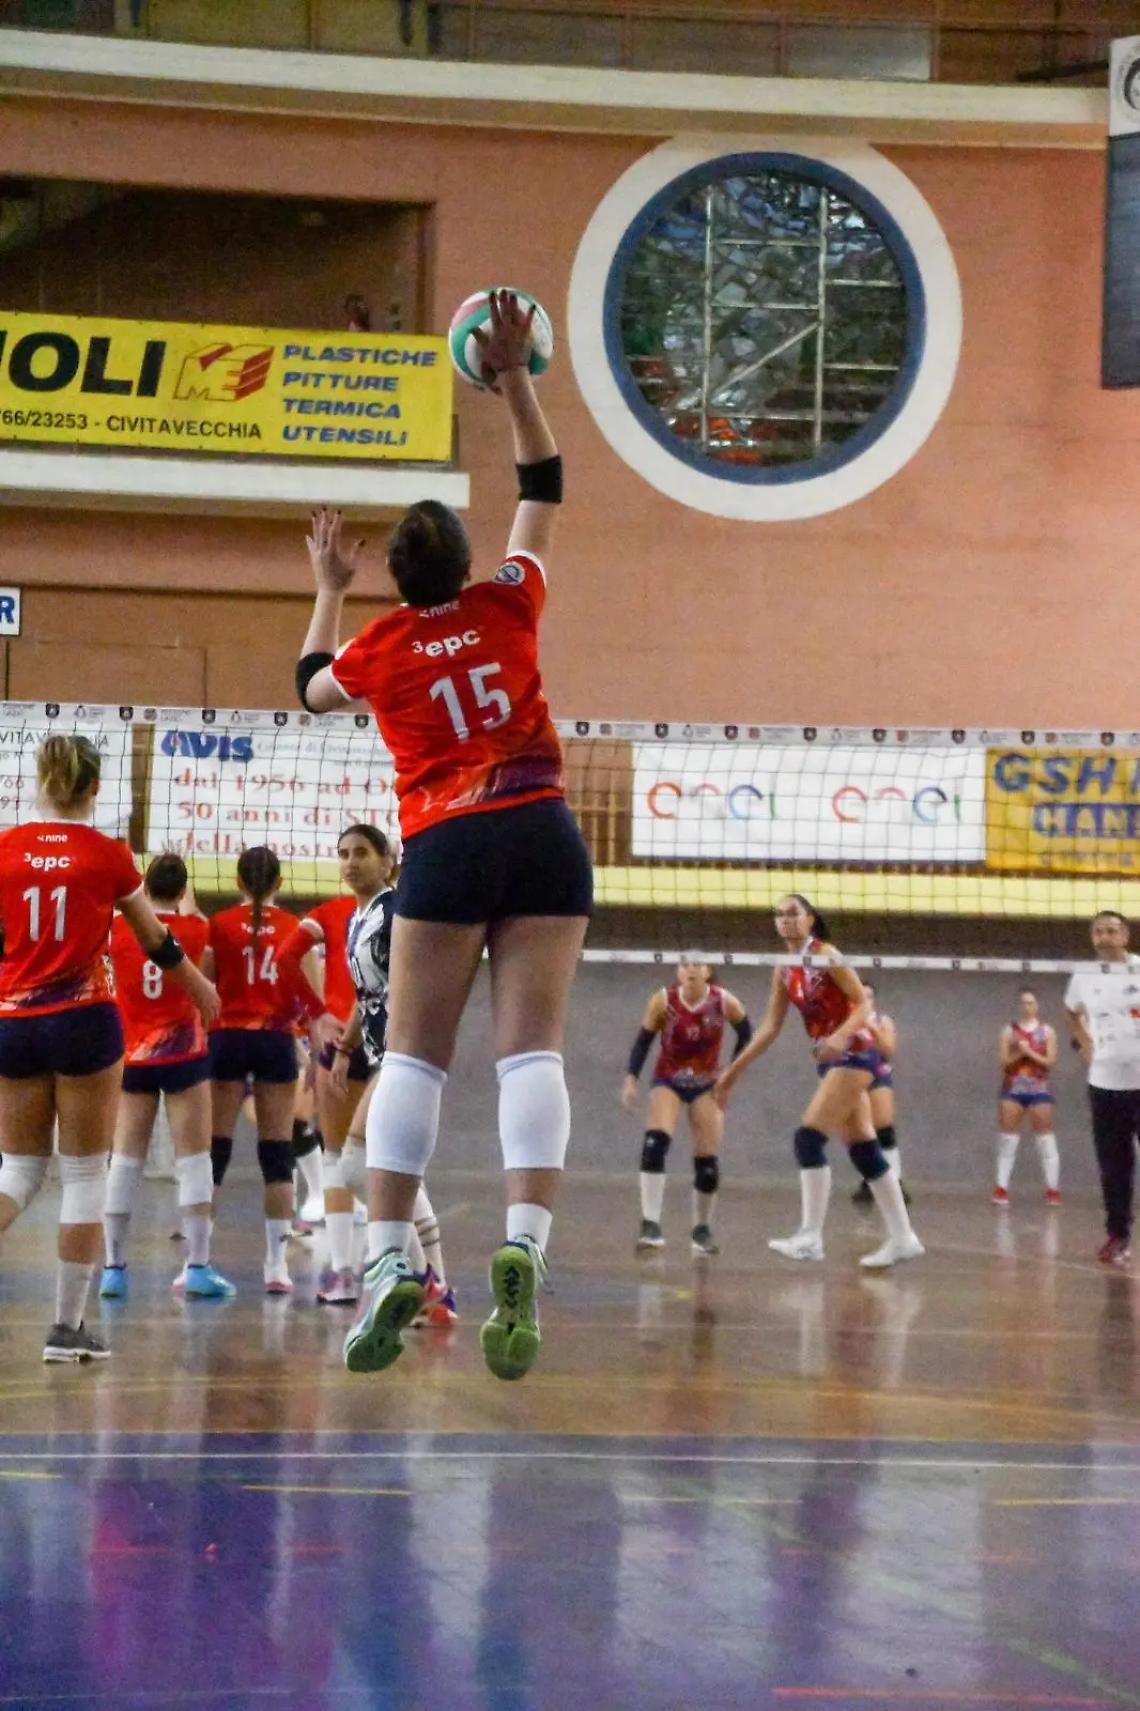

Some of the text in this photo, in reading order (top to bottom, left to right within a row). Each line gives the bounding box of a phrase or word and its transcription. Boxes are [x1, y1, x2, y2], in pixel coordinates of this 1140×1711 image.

[0, 330, 167, 397] OLI
[283, 345, 437, 367] PLASTICHE
[283, 372, 399, 391] PITTURE
[283, 398, 401, 418] TERMICA
[0, 409, 88, 430] 66/23253
[106, 415, 262, 439] CIVITAVECCHIA
[283, 425, 408, 445] UTENSILI
[429, 661, 511, 744] 15
[161, 730, 254, 763] AVIS
[235, 773, 306, 793] 1956
[177, 801, 214, 820] 50
[226, 805, 291, 824] anni
[303, 806, 333, 826] di
[23, 886, 67, 942] 11
[142, 960, 164, 1000] 8
[242, 945, 279, 985] 14
